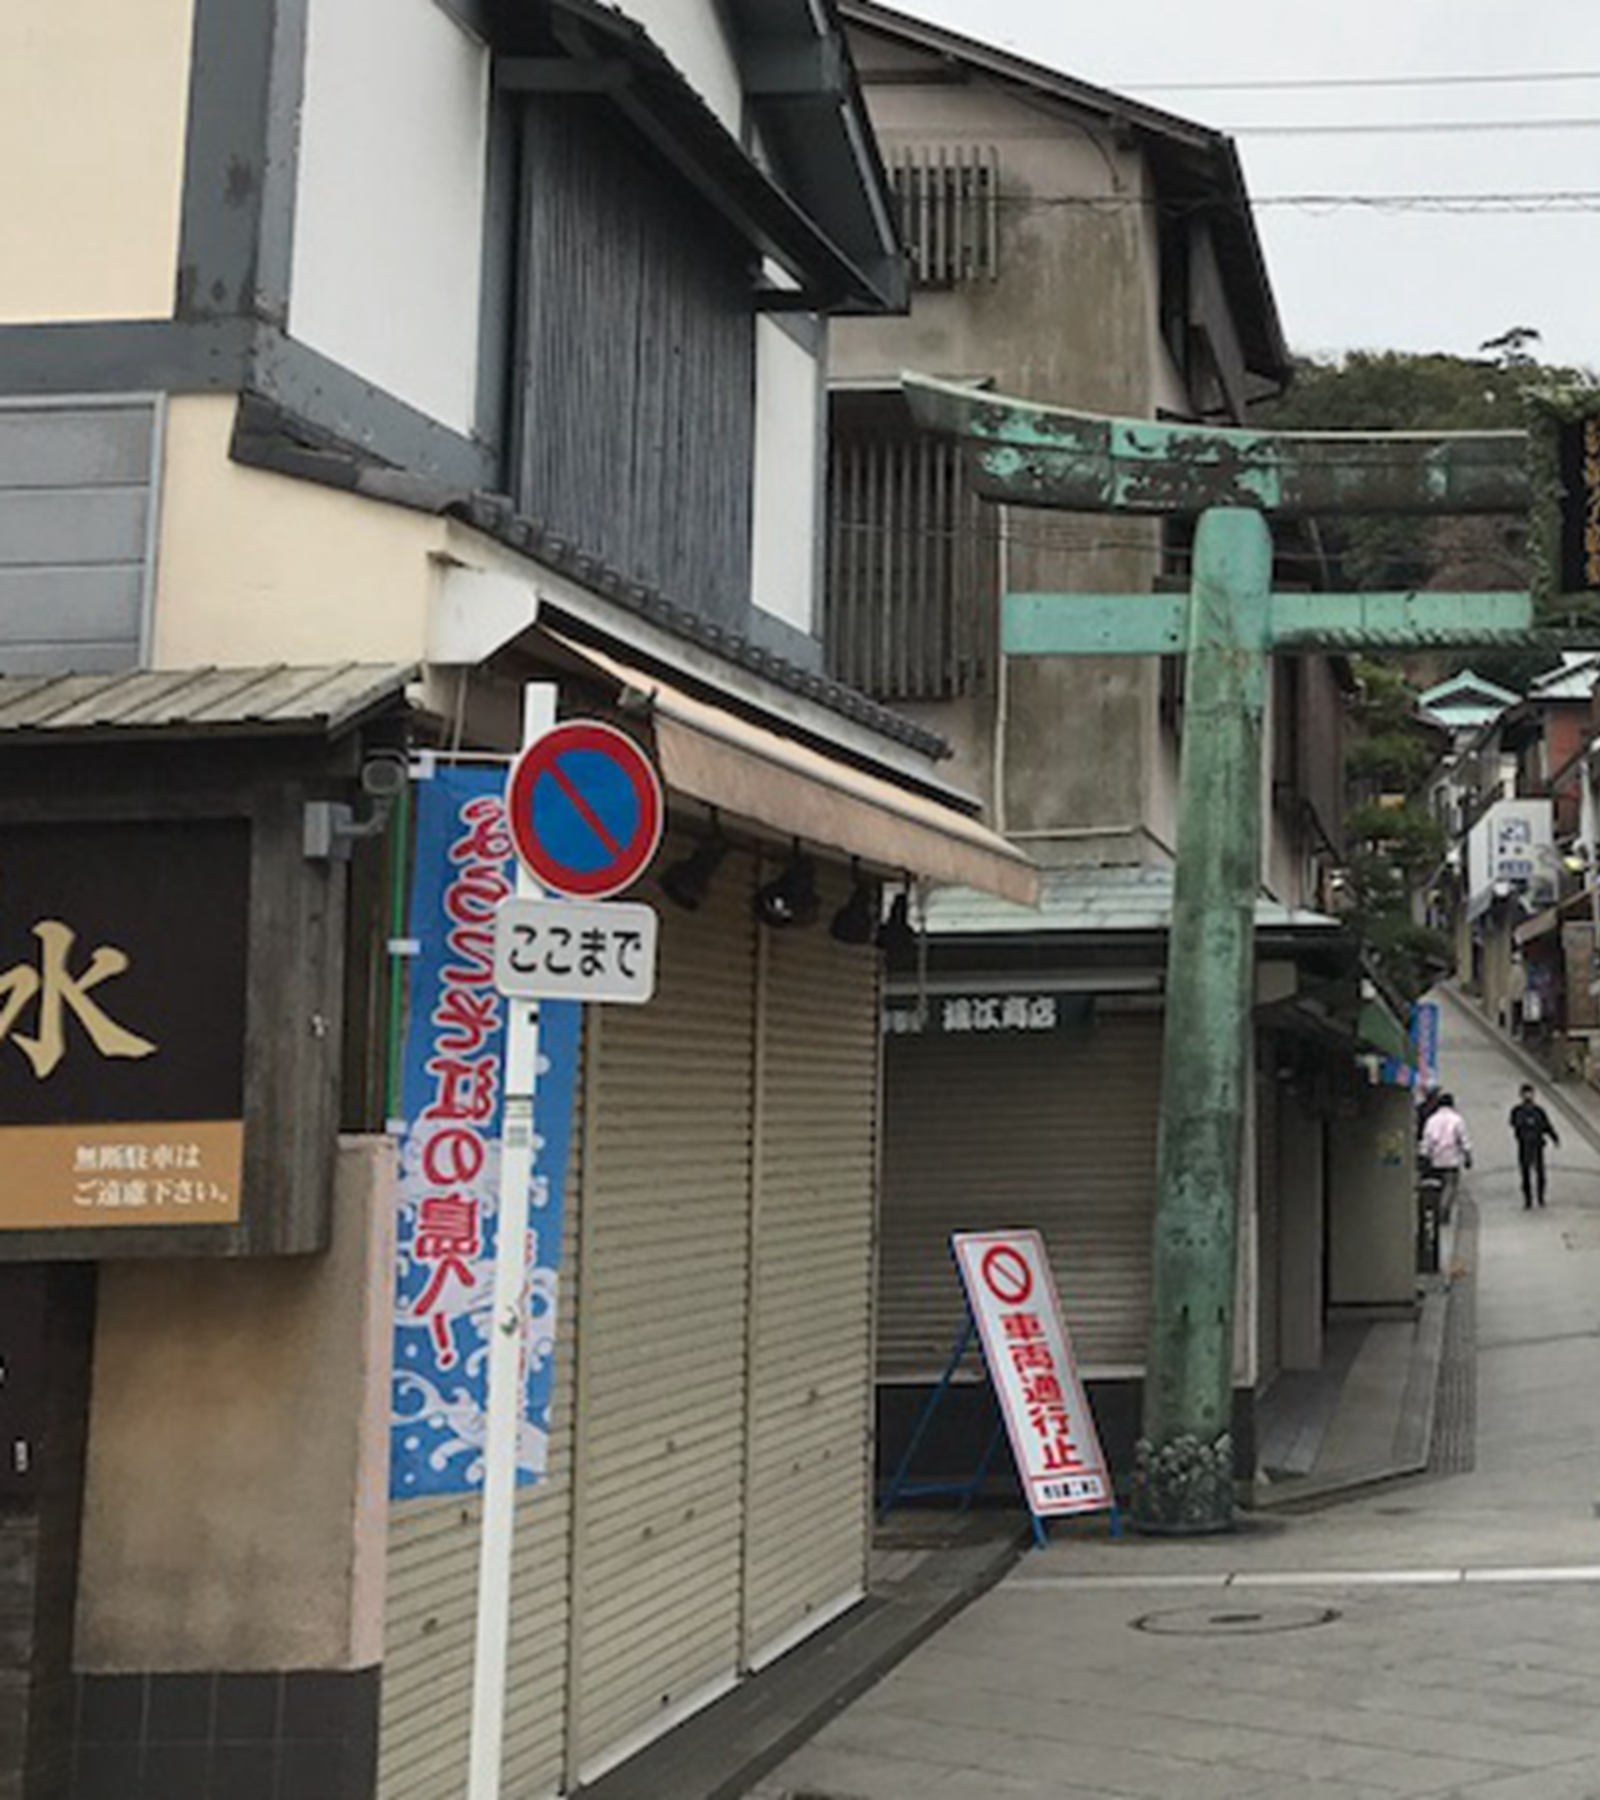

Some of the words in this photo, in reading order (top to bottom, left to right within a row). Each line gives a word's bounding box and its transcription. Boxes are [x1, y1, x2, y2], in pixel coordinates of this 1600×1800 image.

[510, 924, 642, 978] ここまで
[0, 919, 159, 1080] 水
[73, 1144, 201, 1172] 無断駐車は
[73, 1177, 230, 1206] ご遠慮下さい。
[999, 1313, 1082, 1470] 車両通行止
